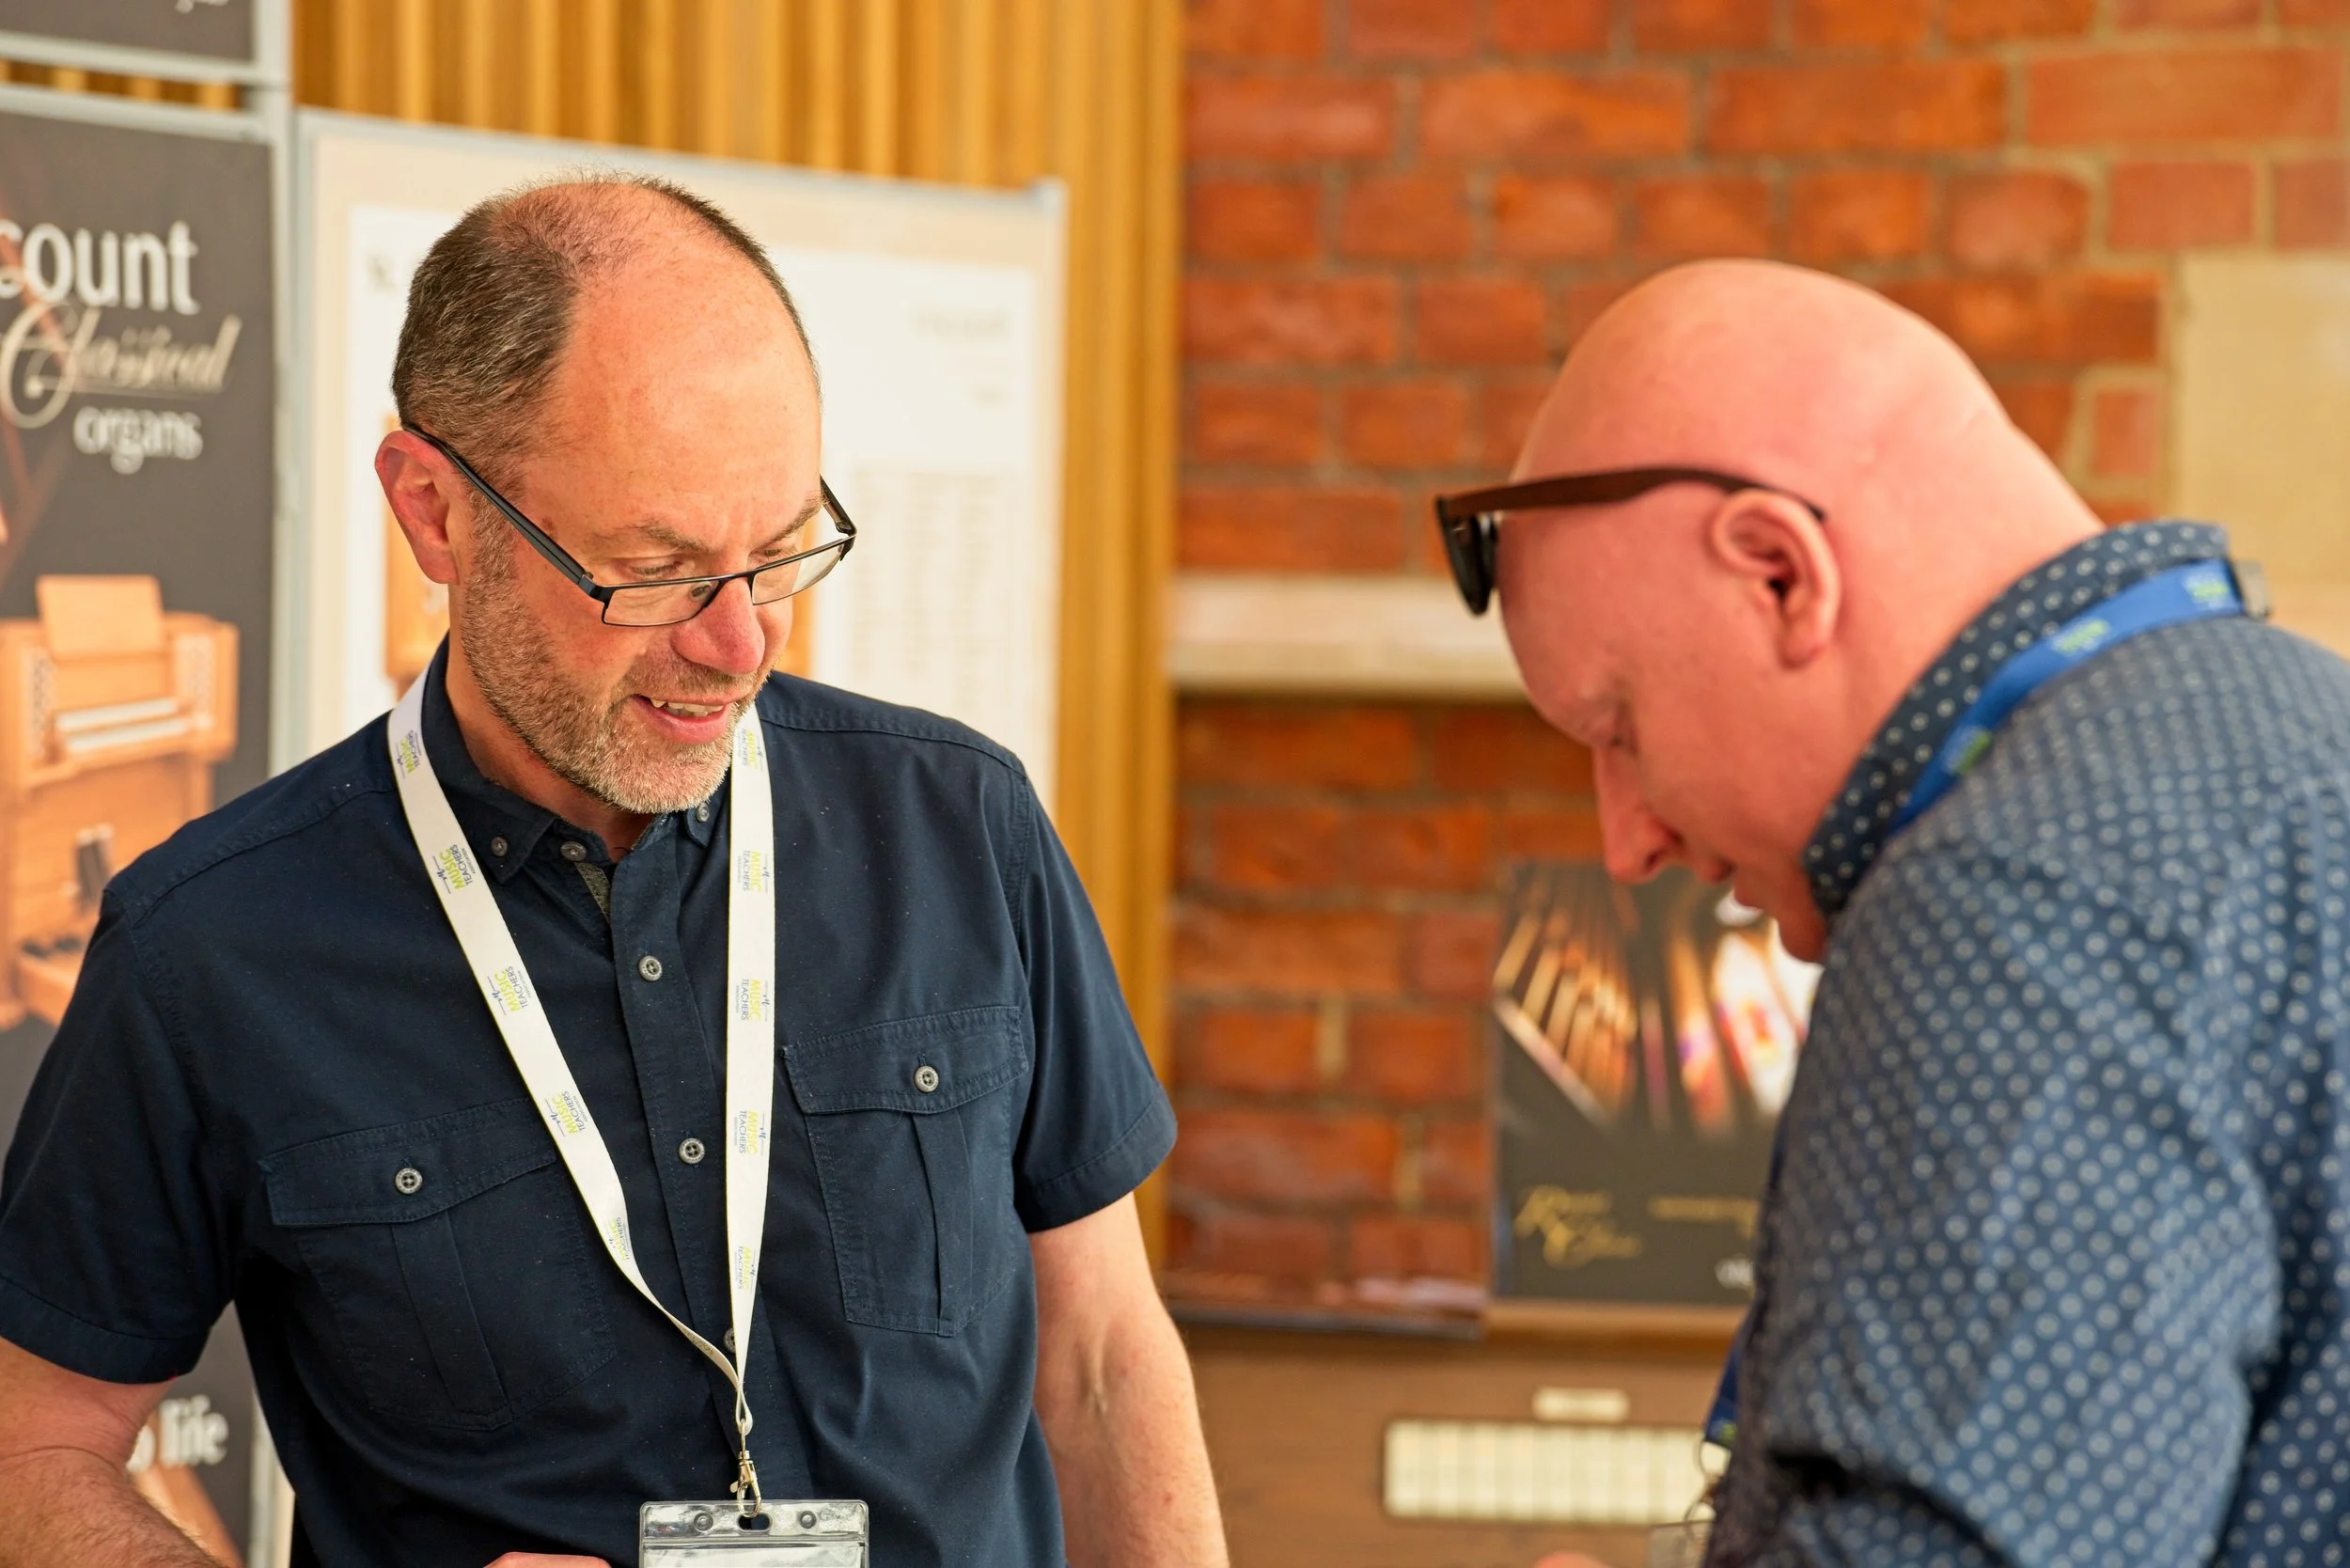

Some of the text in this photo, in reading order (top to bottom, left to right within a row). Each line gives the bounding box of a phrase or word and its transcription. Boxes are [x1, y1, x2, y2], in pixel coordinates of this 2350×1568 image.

[73, 406, 203, 475] organs
[440, 848, 466, 889] MUSIC
[450, 844, 474, 886] TEACHERS
[742, 850, 751, 892] TEACHERS
[751, 851, 761, 893] MUSIC
[494, 970, 521, 1011] MUSIC
[505, 966, 528, 1009] TEACHERS
[741, 979, 750, 1021] TEACHERS
[749, 979, 761, 1022] MUSIC
[552, 1093, 579, 1134] MUSIC
[561, 1090, 586, 1131] TEACHERS
[738, 1110, 747, 1154] TEACHERS
[746, 1110, 759, 1154] MUSIC
[158, 1395, 229, 1467] life
